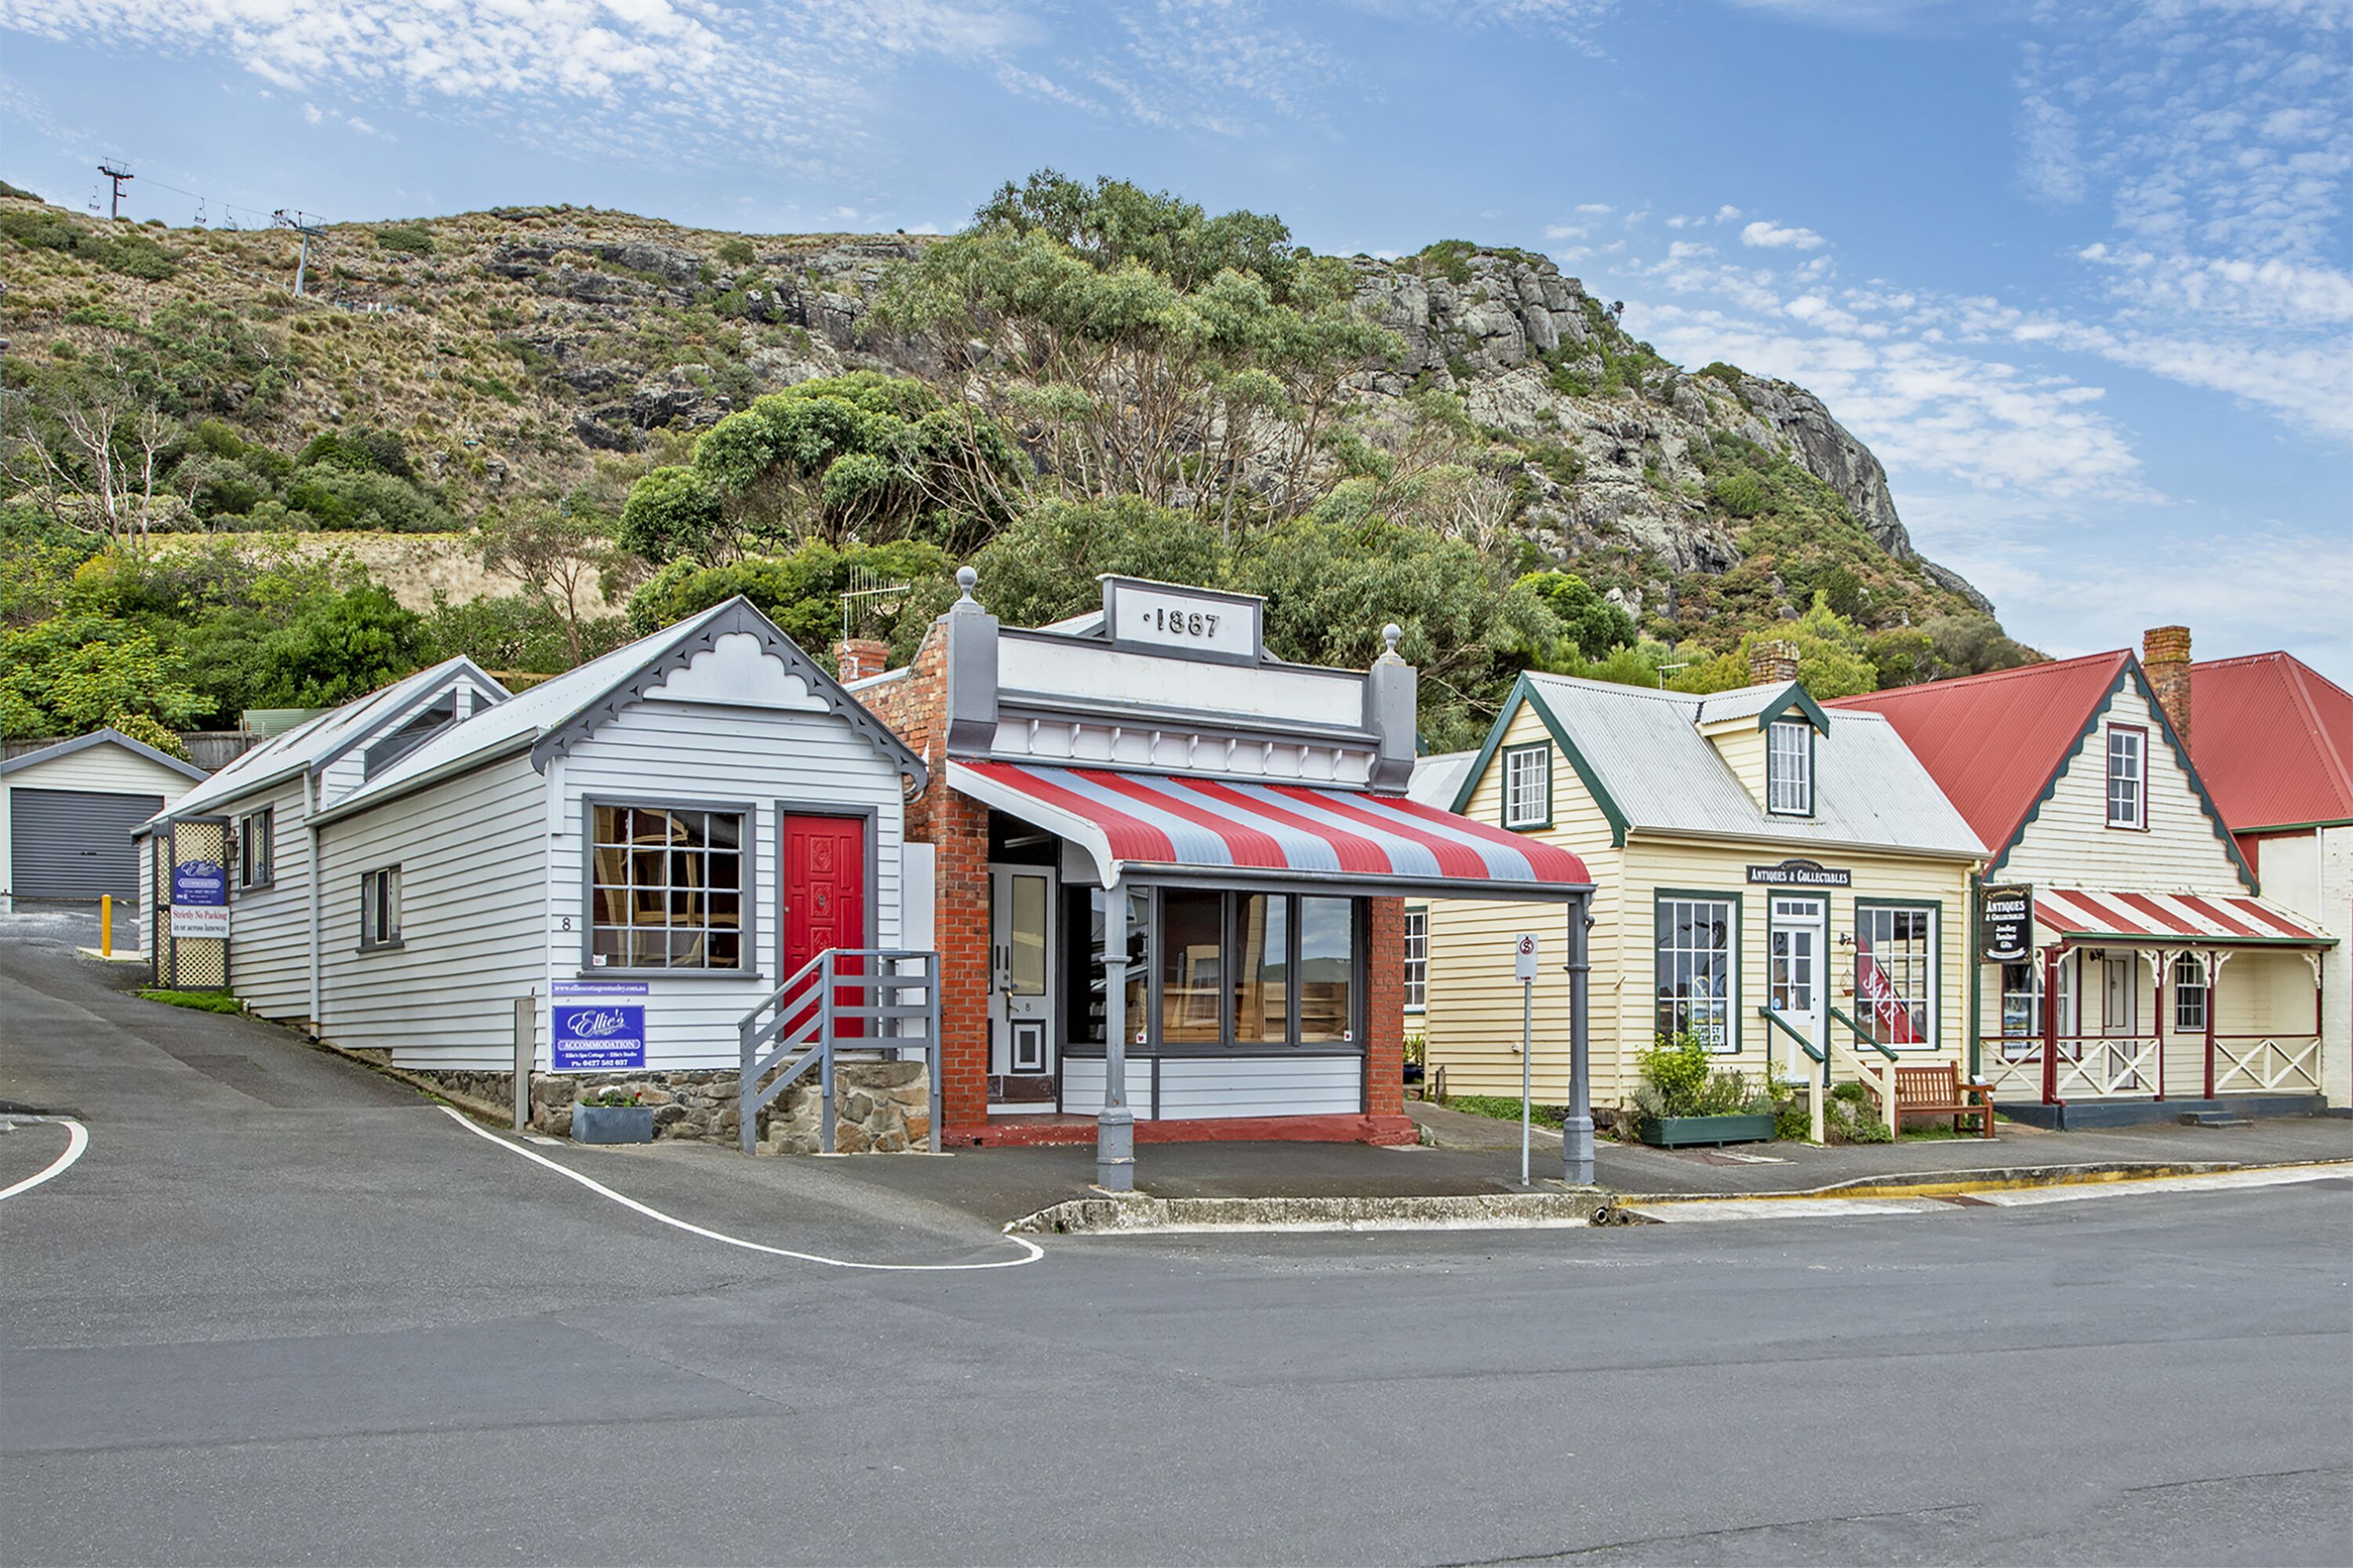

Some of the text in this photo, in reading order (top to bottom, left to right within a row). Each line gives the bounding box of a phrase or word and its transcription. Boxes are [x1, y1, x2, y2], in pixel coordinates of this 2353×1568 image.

[1157, 609, 1220, 638] 1887
[1751, 868, 1848, 884] ANTIQUES & COLLECTABLES
[1985, 900, 2026, 913] ANTIQUES
[173, 910, 227, 921] Strictly No Parking
[173, 922, 179, 931] in
[204, 923, 227, 933] laneway
[562, 917, 571, 931] 8
[1863, 971, 1900, 1025] SALE
[567, 1008, 625, 1038] Ellie's
[564, 1040, 635, 1050] ACCOMMODATION
